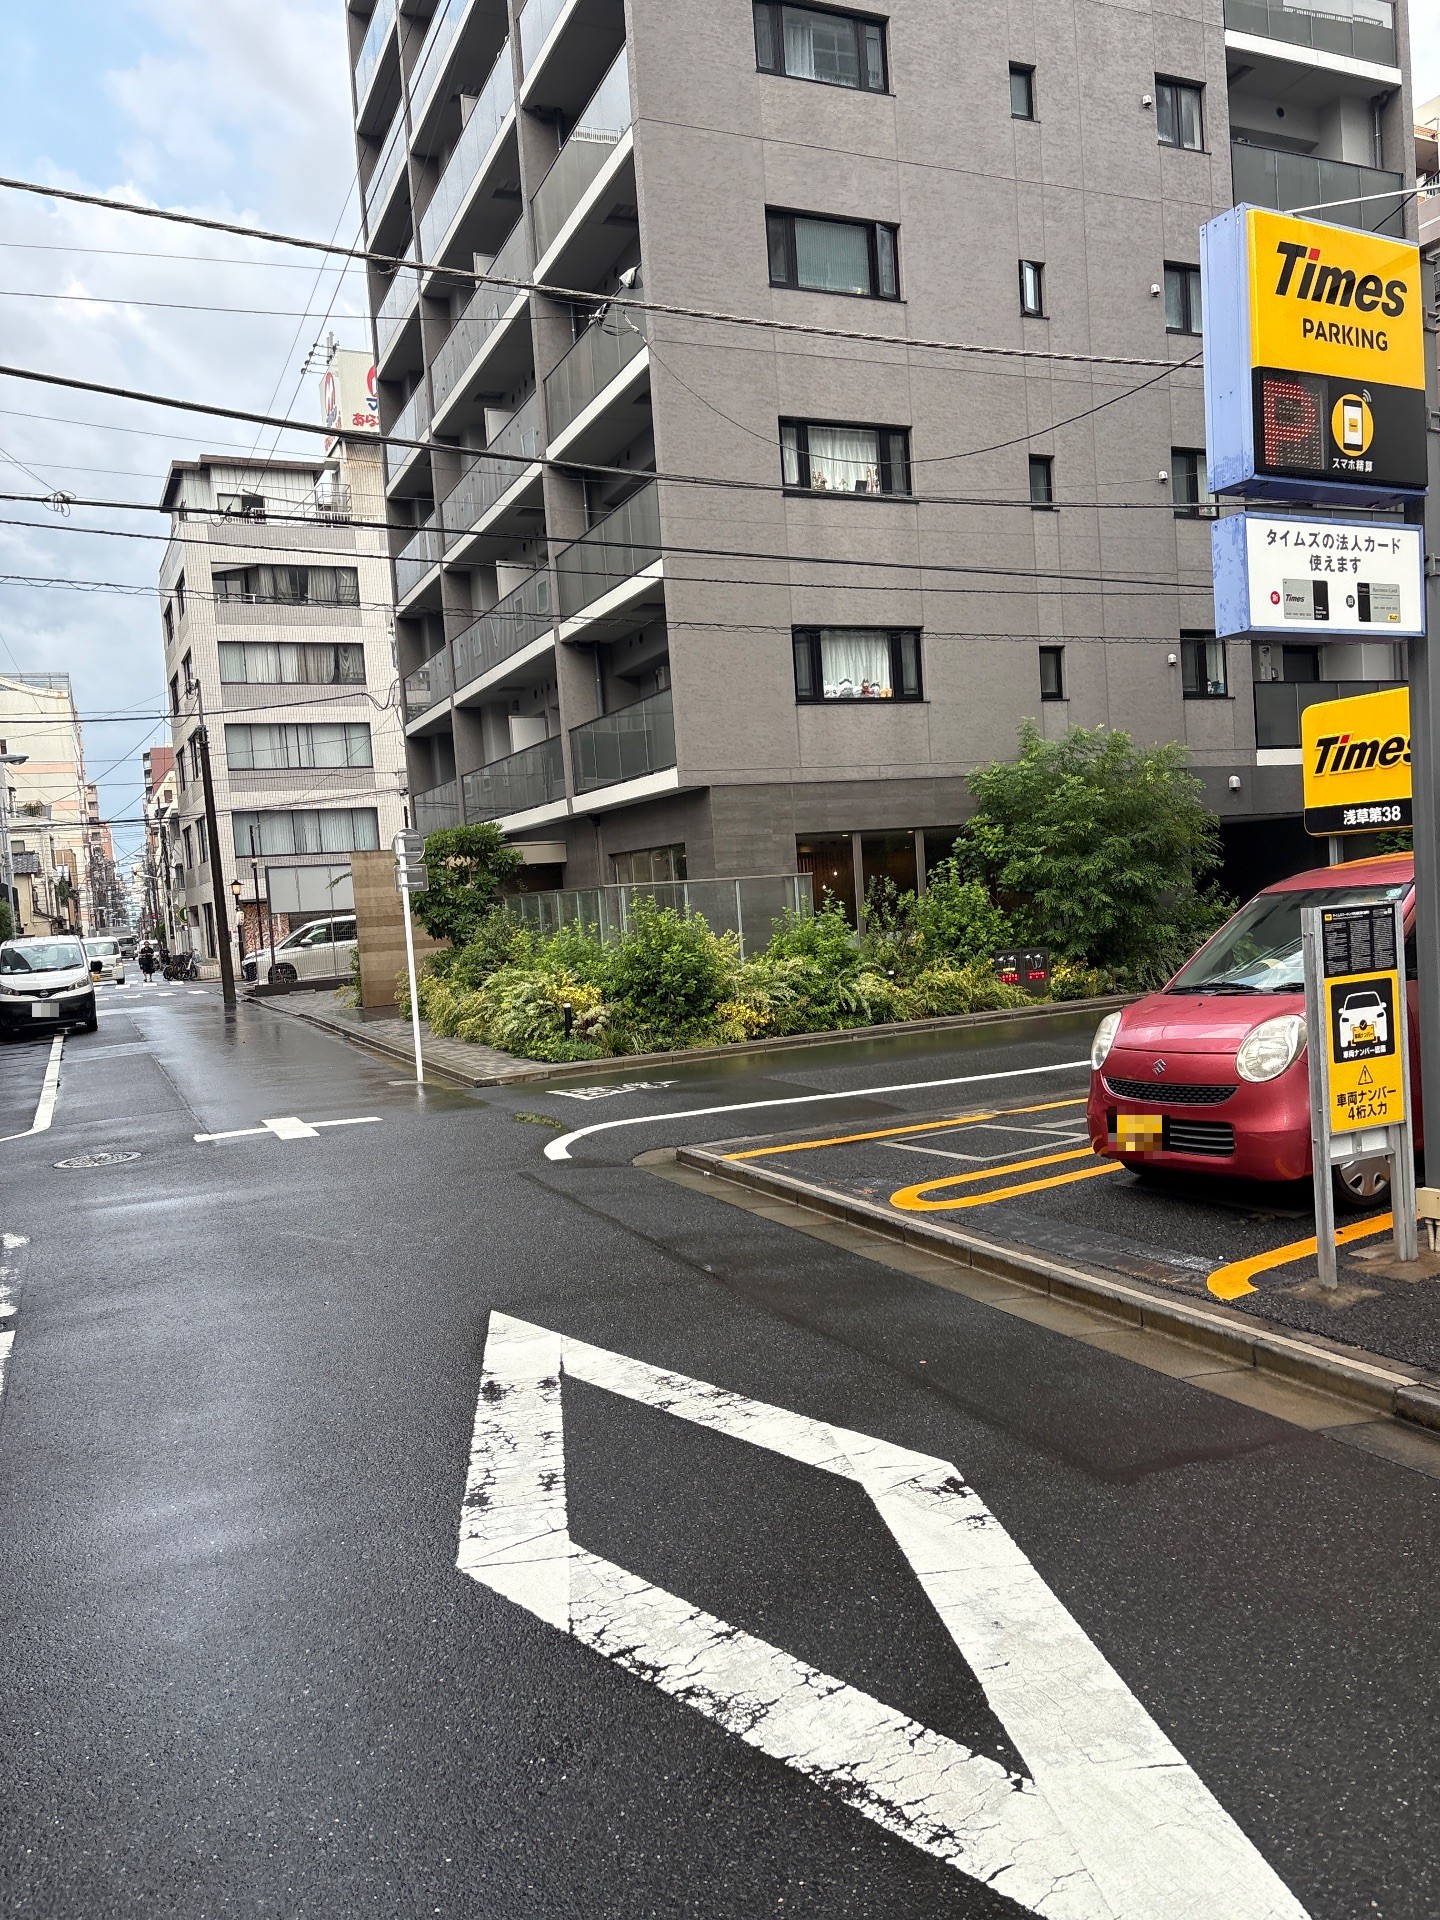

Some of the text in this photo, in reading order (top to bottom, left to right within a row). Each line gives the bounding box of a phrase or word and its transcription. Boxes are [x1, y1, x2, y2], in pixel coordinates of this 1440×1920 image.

[1275, 241, 1408, 317] Times
[1302, 318, 1389, 351] PARKING
[1332, 458, 1374, 473] スマホ精算
[1267, 528, 1401, 554] タイムズの法人カード
[1309, 554, 1362, 574] 使えます
[1285, 593, 1305, 603] Times
[1315, 734, 1411, 774] Time
[1343, 805, 1401, 825] 浅草第38
[1337, 1086, 1396, 1107] 車両ナンバー
[1348, 1101, 1387, 1120] 4桁入力
